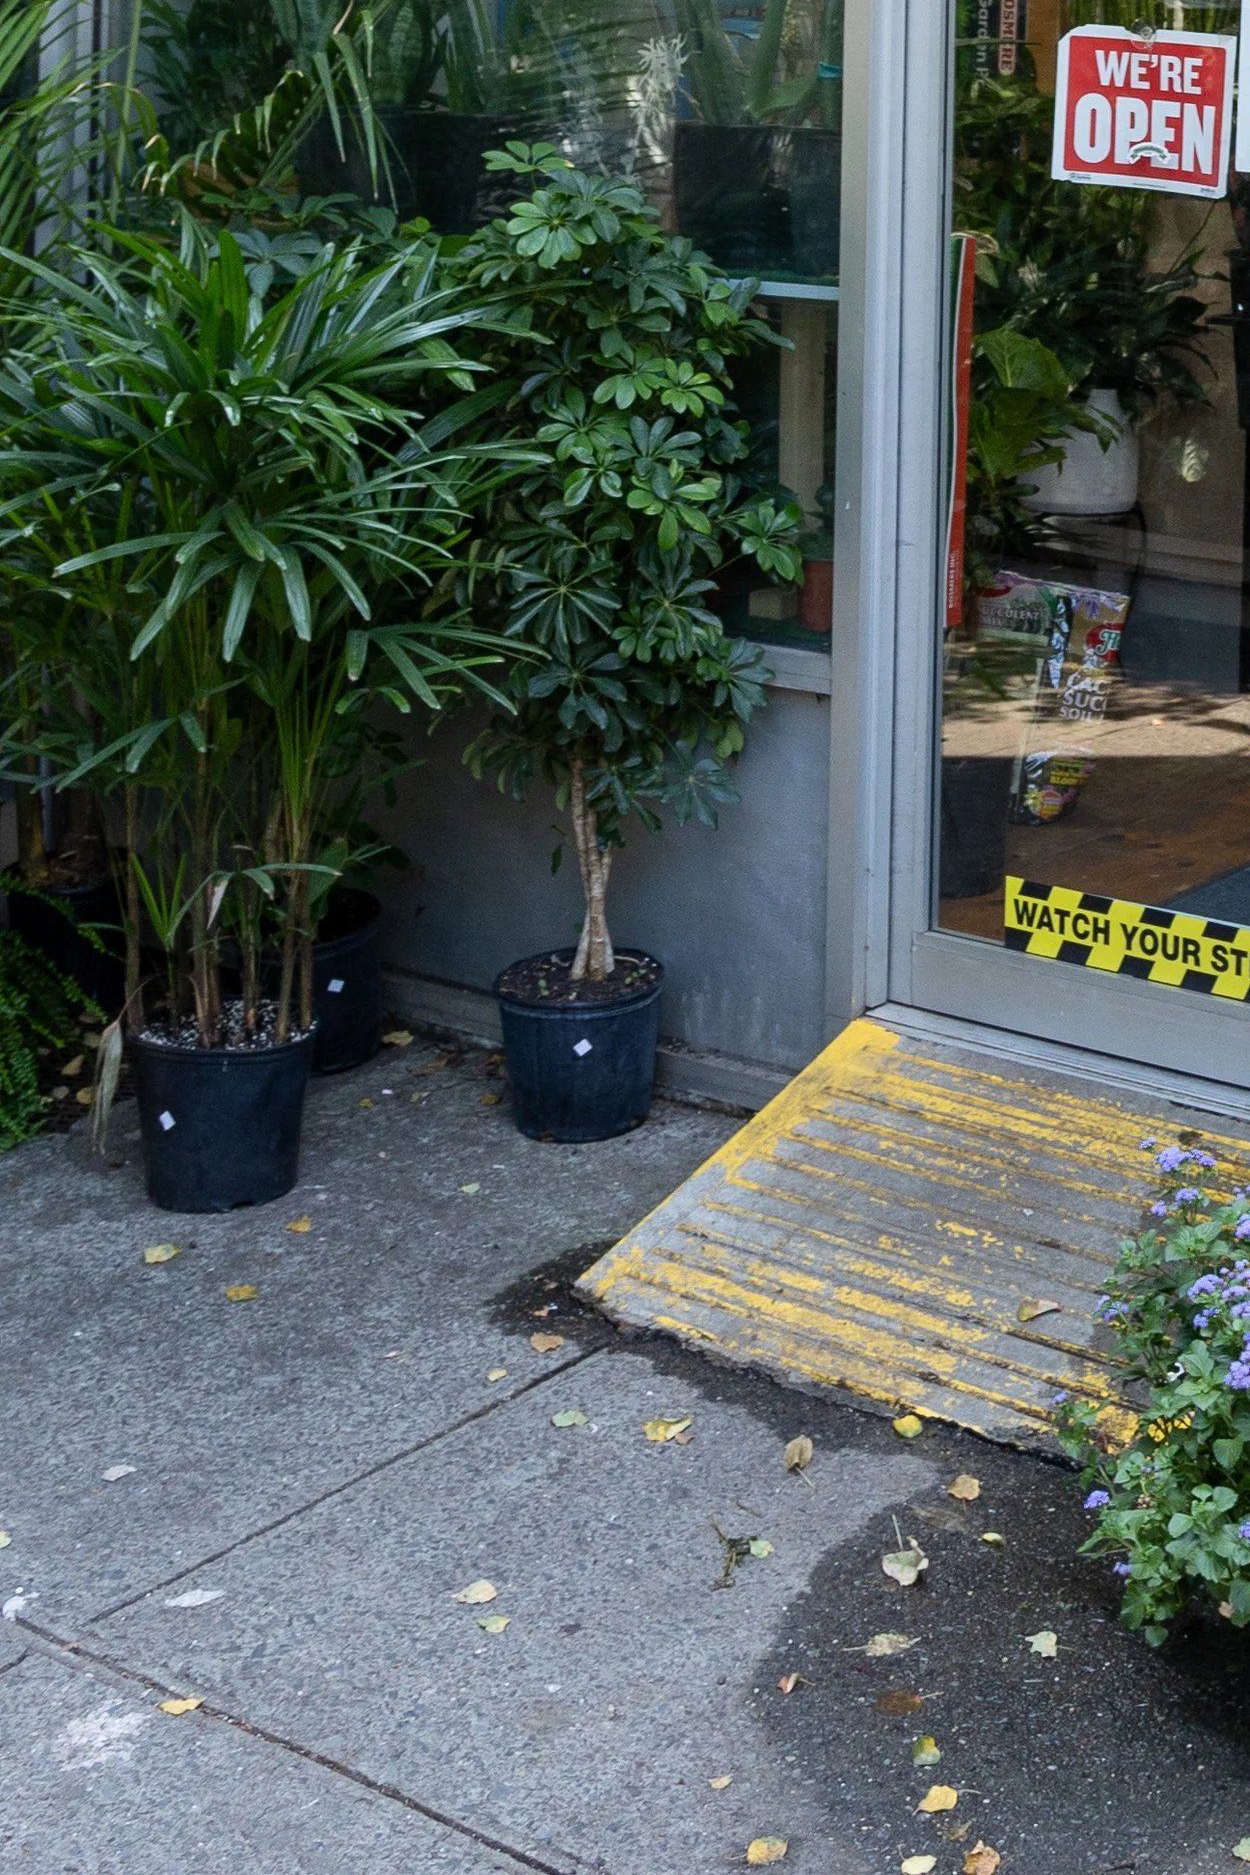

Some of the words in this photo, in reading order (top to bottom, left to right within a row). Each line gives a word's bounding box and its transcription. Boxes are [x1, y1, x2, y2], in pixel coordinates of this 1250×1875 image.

[1095, 50, 1203, 95] WE'RE
[1073, 92, 1217, 175] OPEN
[1013, 898, 1110, 946] WATCH
[1120, 923, 1202, 967] YOUR
